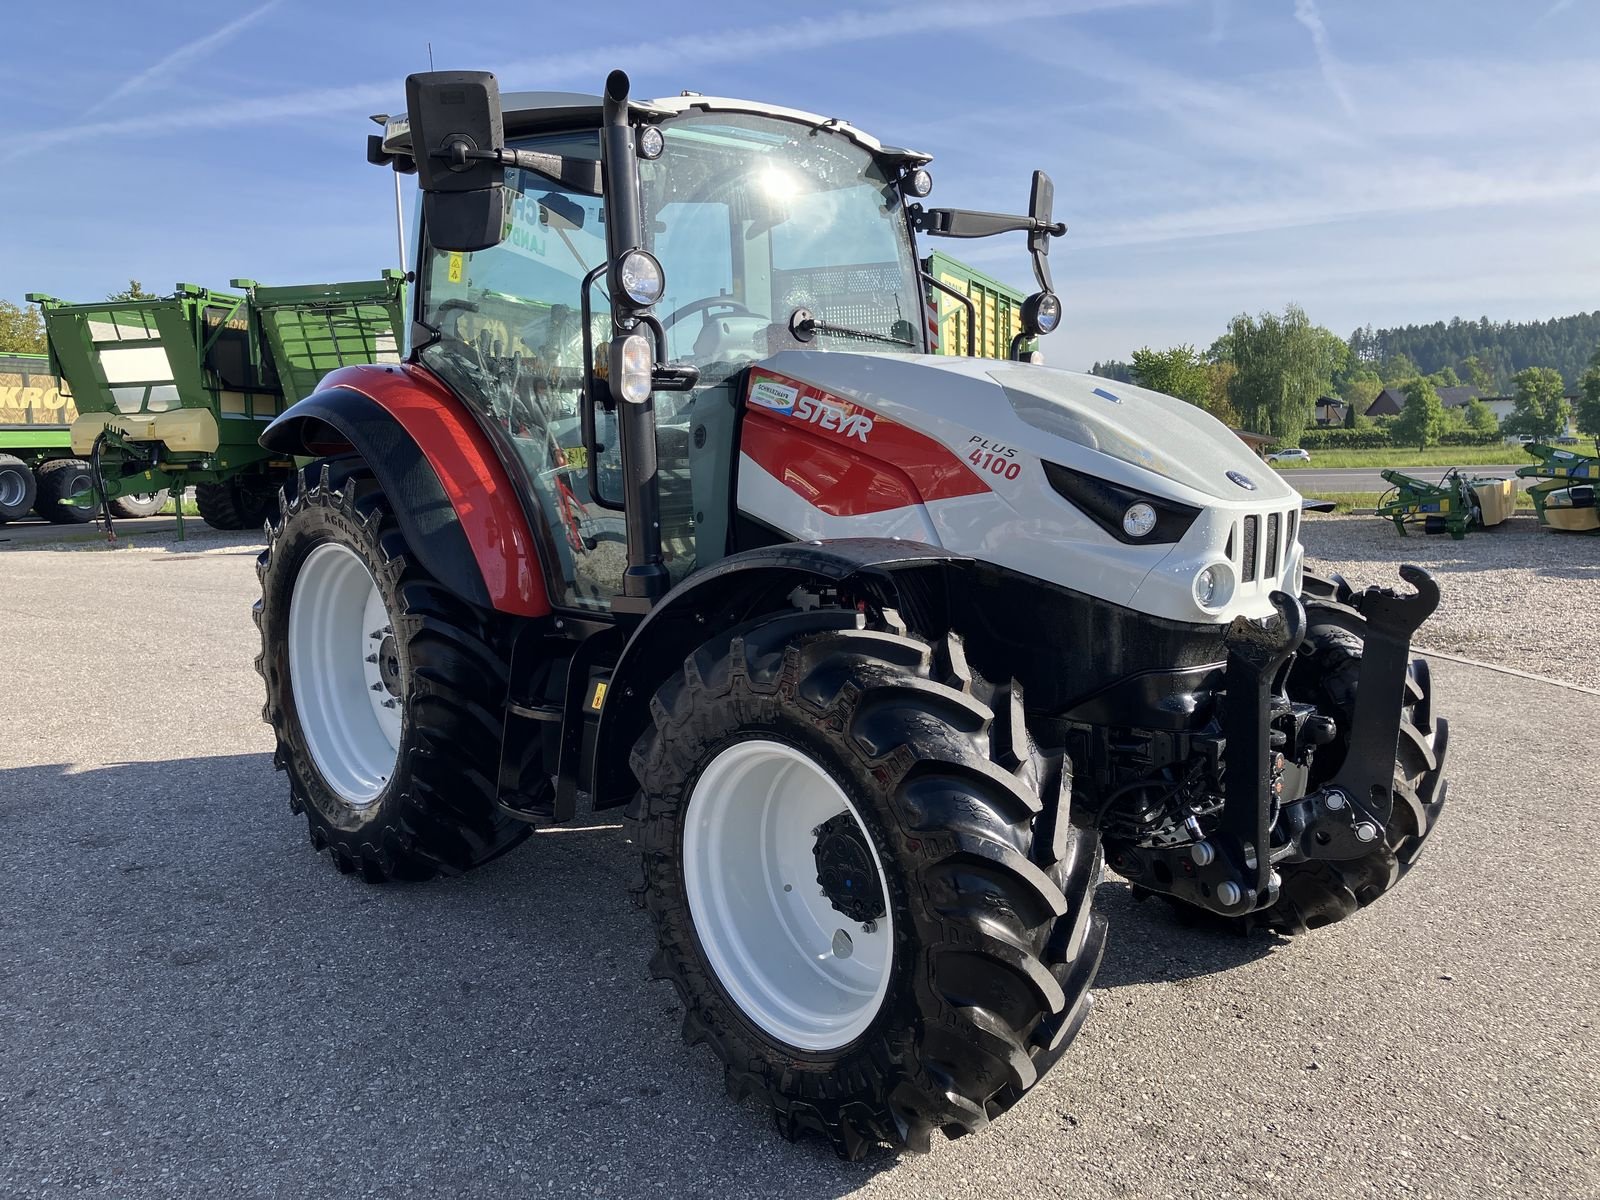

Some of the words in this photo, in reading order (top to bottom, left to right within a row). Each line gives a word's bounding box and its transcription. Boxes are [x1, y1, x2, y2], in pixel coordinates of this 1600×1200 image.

[792, 396, 873, 443] STEYR
[968, 435, 1018, 458] PLUS
[968, 448, 1021, 480] 4100
